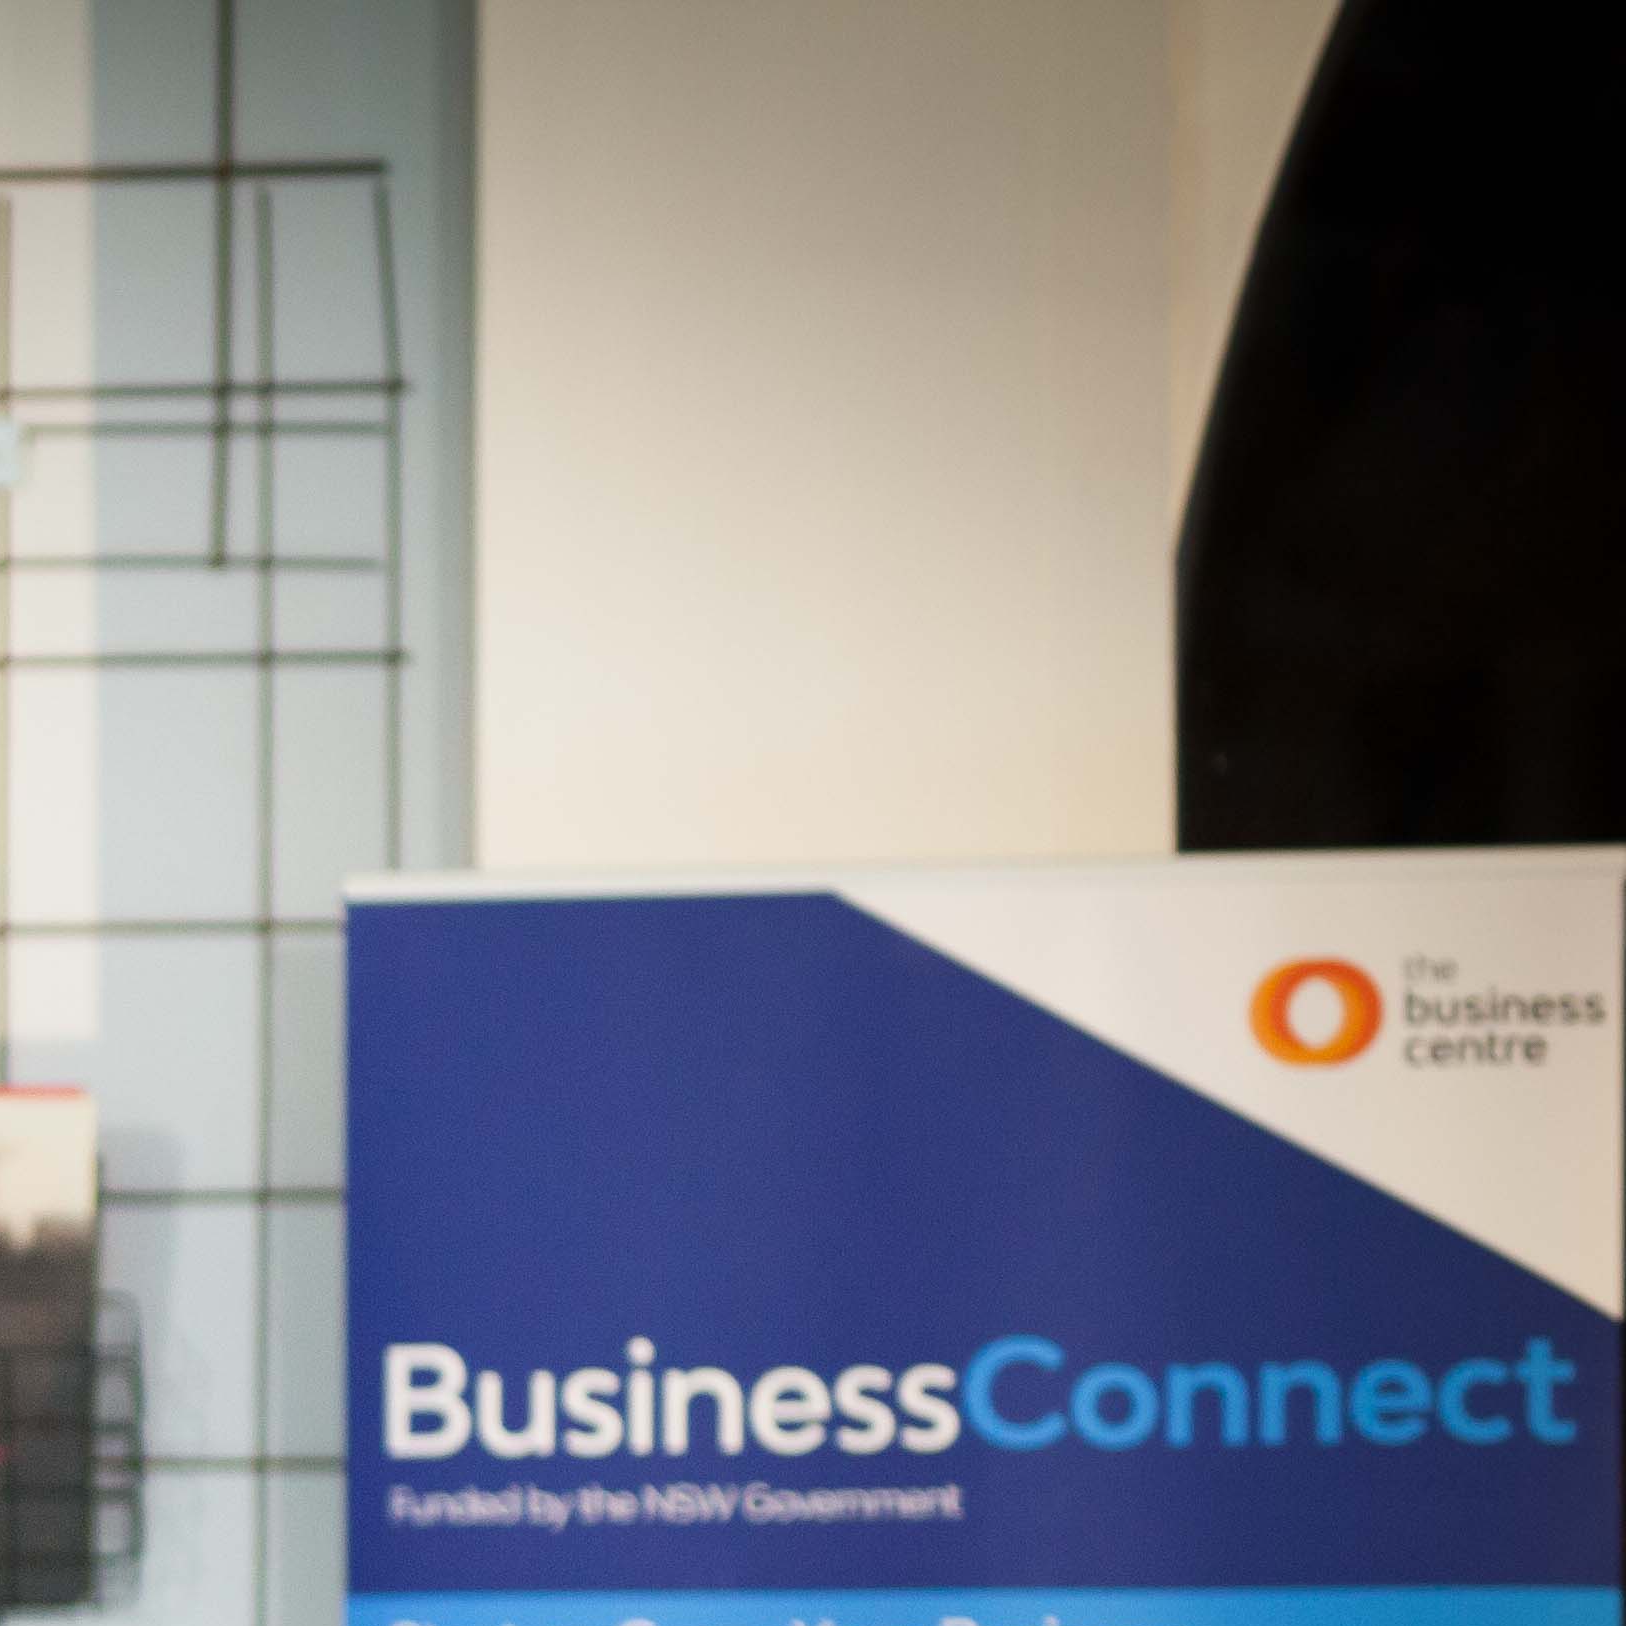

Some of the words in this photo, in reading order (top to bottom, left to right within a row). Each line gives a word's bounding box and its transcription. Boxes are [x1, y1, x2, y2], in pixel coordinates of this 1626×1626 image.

[1402, 953, 1458, 981] the
[1403, 987, 1607, 1025] business
[1403, 1031, 1548, 1066] centre
[389, 1485, 523, 1527] Funded
[526, 1485, 570, 1532] by
[579, 1486, 638, 1522] the
[644, 1483, 742, 1523] NSW
[743, 1482, 964, 1521] Government
